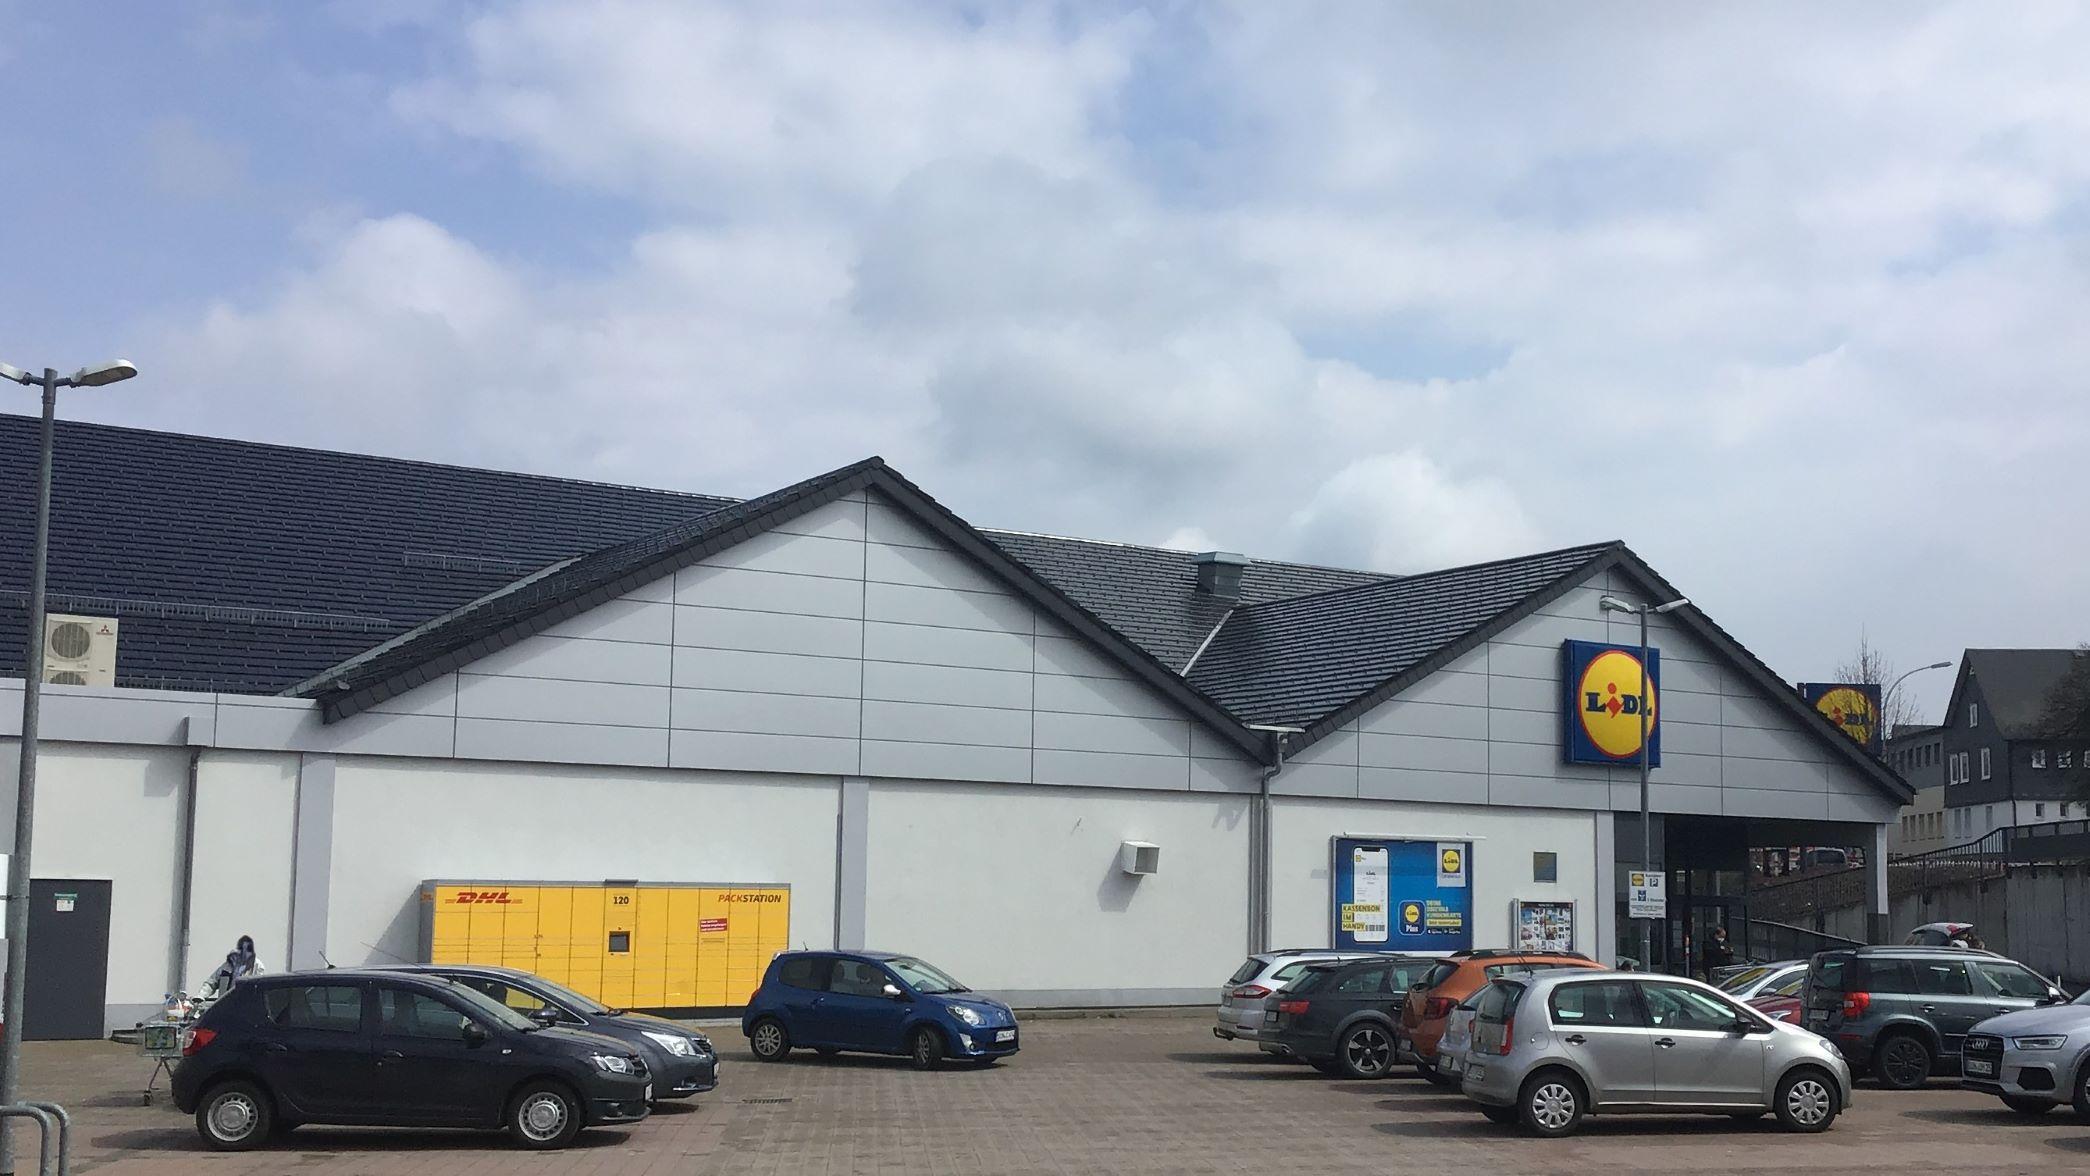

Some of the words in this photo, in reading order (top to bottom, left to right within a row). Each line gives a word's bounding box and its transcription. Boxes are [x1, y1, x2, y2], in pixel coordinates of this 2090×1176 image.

[456, 892, 511, 904] DHL
[613, 896, 630, 905] 120
[718, 894, 781, 903] PACKSTATION
